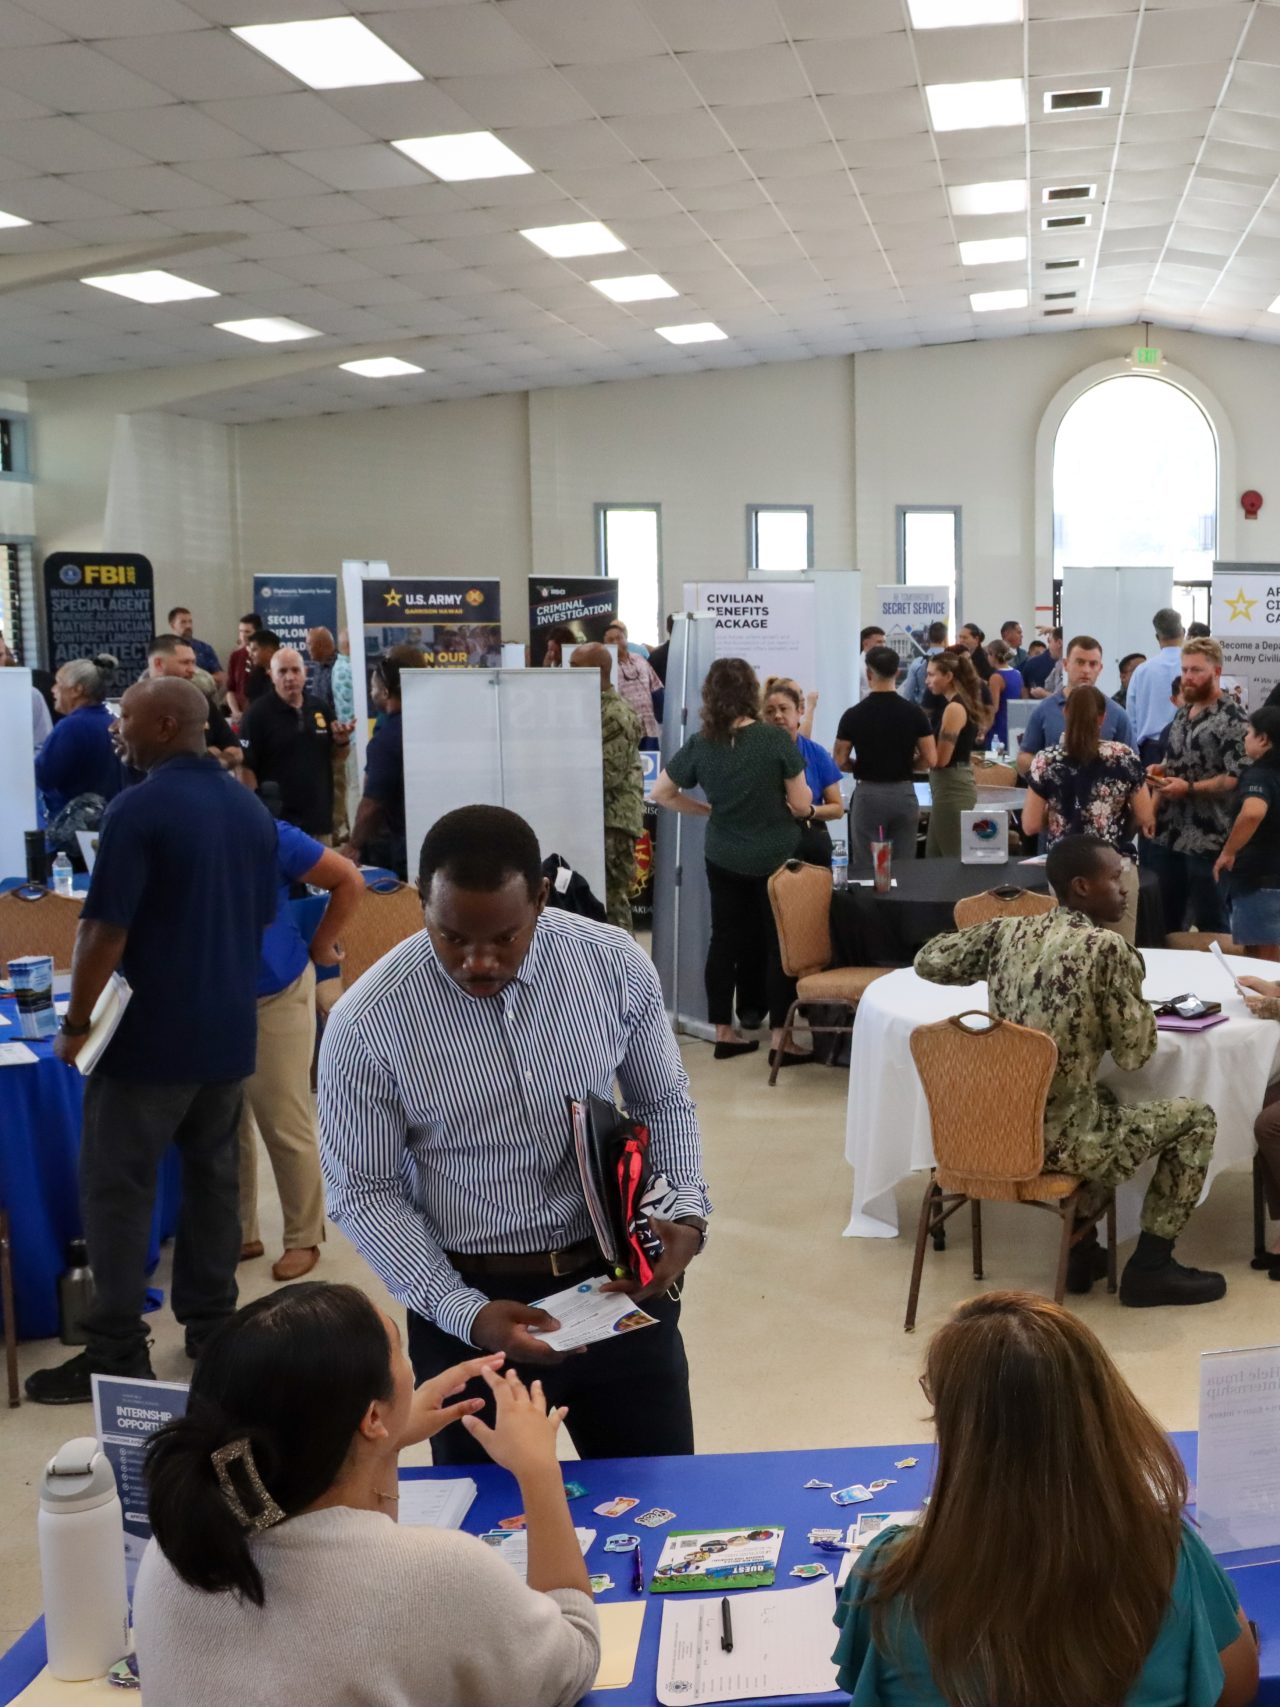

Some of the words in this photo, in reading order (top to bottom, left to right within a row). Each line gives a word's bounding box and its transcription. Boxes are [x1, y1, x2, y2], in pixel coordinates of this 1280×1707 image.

[1137, 348, 1158, 364] EXIT
[84, 565, 126, 584] FBI
[112, 589, 151, 598] ANALYST
[707, 594, 764, 603] CIVILIAN
[51, 598, 107, 611] SPECIAL
[108, 598, 151, 611] AGENT
[405, 594, 427, 605] U.S.
[428, 594, 463, 605] ARMY
[536, 599, 585, 616] CRIMINAL
[882, 602, 911, 615] SECRET
[913, 602, 945, 615] SERVICE
[536, 603, 613, 625] INVESTIGATION
[267, 615, 305, 625] SECURE
[715, 619, 768, 629] ACKAGE
[53, 621, 152, 632] MATHEMATICIAN
[53, 633, 106, 643] CONTRACT
[108, 633, 152, 643] LINGUIST
[279, 641, 306, 651] ORLD
[1219, 641, 1253, 650] Become
[55, 643, 150, 660] ARCHITECT
[438, 652, 468, 662] OUR
[1234, 653, 1256, 664] Army
[116, 1405, 173, 1422] INTERNSHIP
[732, 1564, 764, 1575] QUEST
